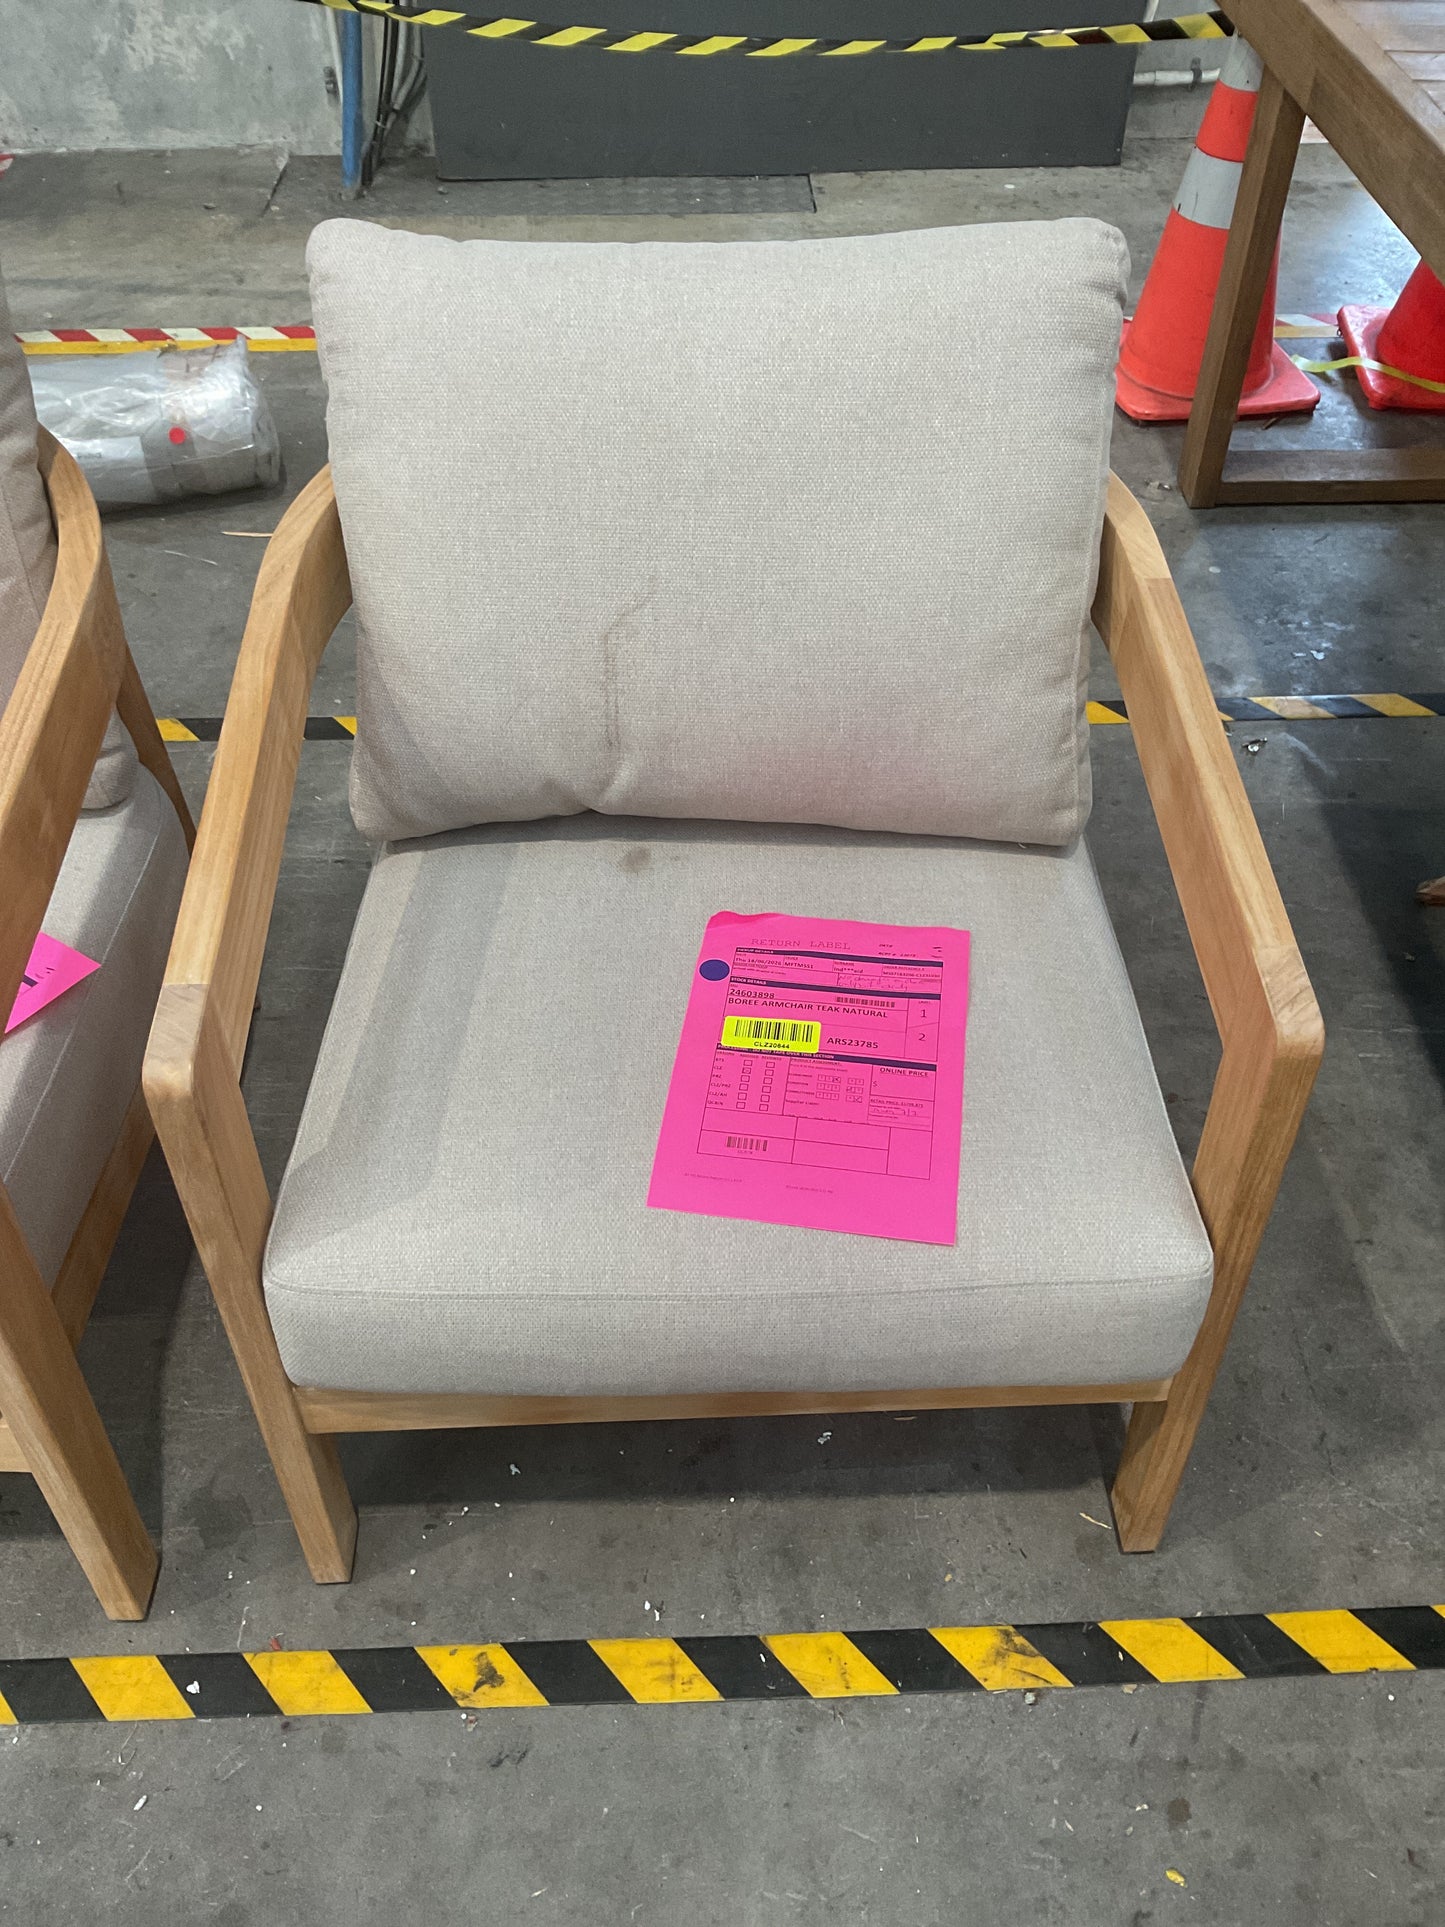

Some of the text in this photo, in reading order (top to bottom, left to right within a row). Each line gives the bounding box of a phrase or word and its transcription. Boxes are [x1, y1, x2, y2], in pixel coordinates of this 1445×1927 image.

[751, 938, 851, 950] RETURN LABEL
[730, 988, 775, 999] 24603898
[728, 998, 888, 1018] BOREE ARMCHAIR TEAK NATURAL
[921, 1009, 927, 1017] 1
[918, 1033, 926, 1041] 2
